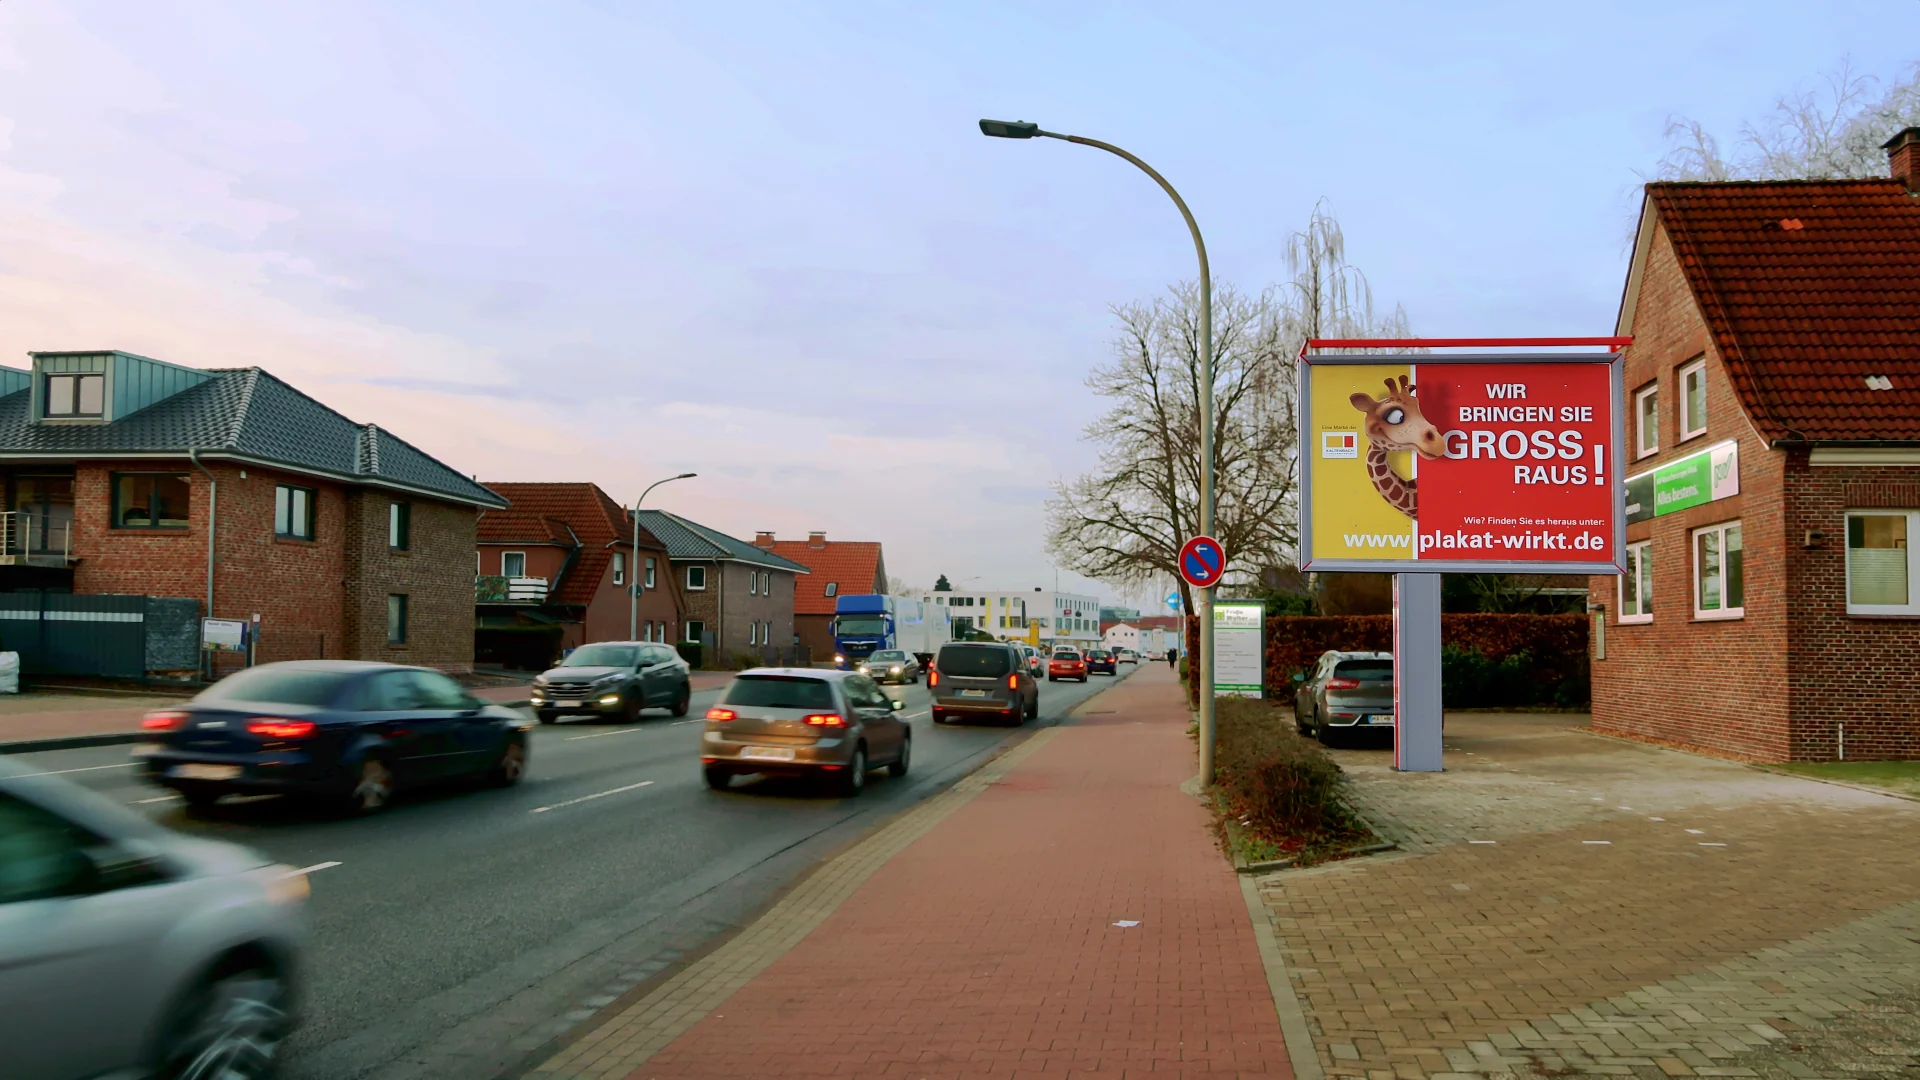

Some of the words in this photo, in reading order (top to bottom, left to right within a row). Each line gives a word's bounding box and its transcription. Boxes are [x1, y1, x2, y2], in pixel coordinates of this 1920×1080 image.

[1485, 383, 1527, 399] WIR
[1459, 406, 1554, 422] BRINGEN
[1560, 406, 1593, 422] SIE
[1442, 429, 1584, 460] GROSS
[1463, 516, 1486, 525] Wie?
[1488, 516, 1517, 525] Finden
[1519, 517, 1533, 525] Sie
[1547, 517, 1577, 526] heraus
[1419, 529, 1605, 552] plakat-wirkt.de
